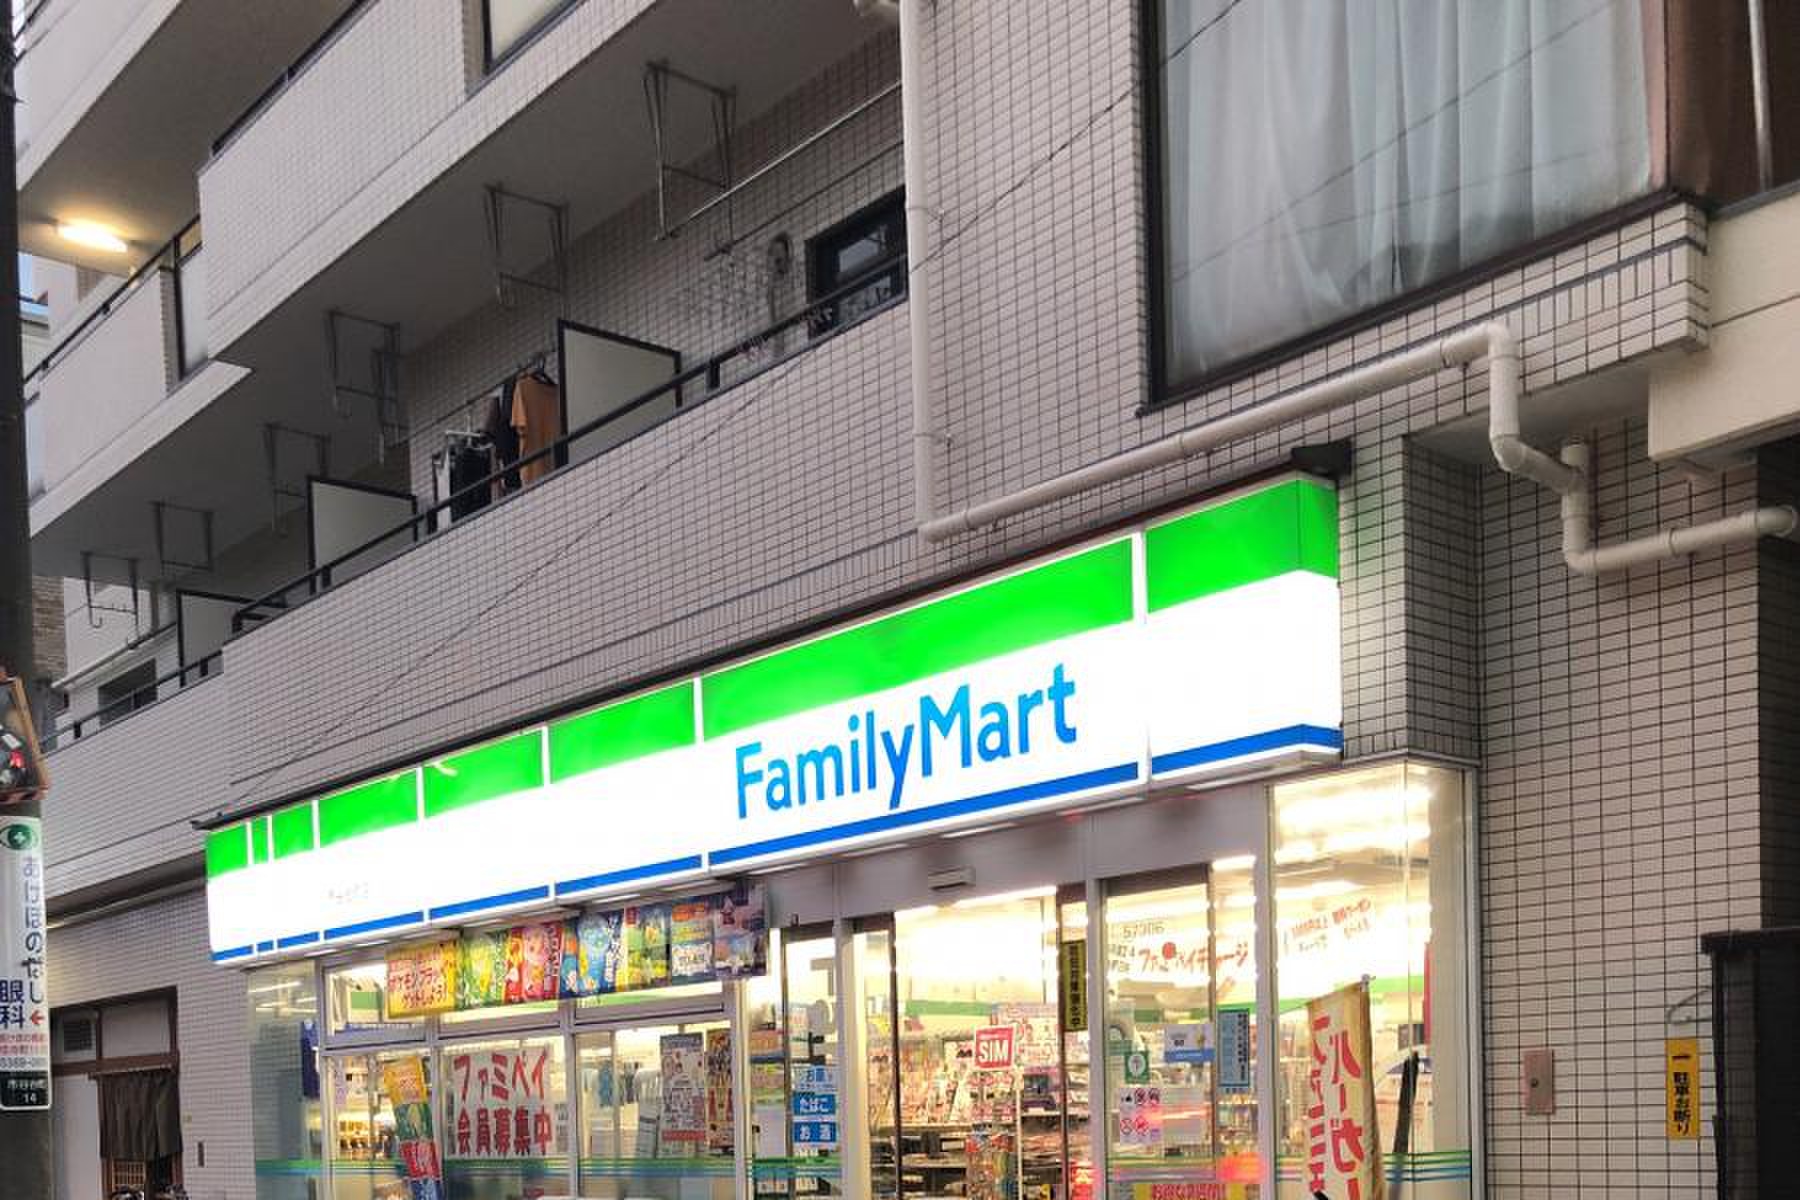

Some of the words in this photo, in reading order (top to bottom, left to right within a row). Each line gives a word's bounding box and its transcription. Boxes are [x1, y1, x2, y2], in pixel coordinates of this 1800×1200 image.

[735, 663, 1077, 819] FamilyMart
[0, 979, 25, 1029] 眼科
[454, 1048, 548, 1103] ファミペイ
[978, 1039, 1009, 1063] SIM
[457, 1105, 553, 1157] 会員募集中
[799, 1097, 830, 1114] たばこ
